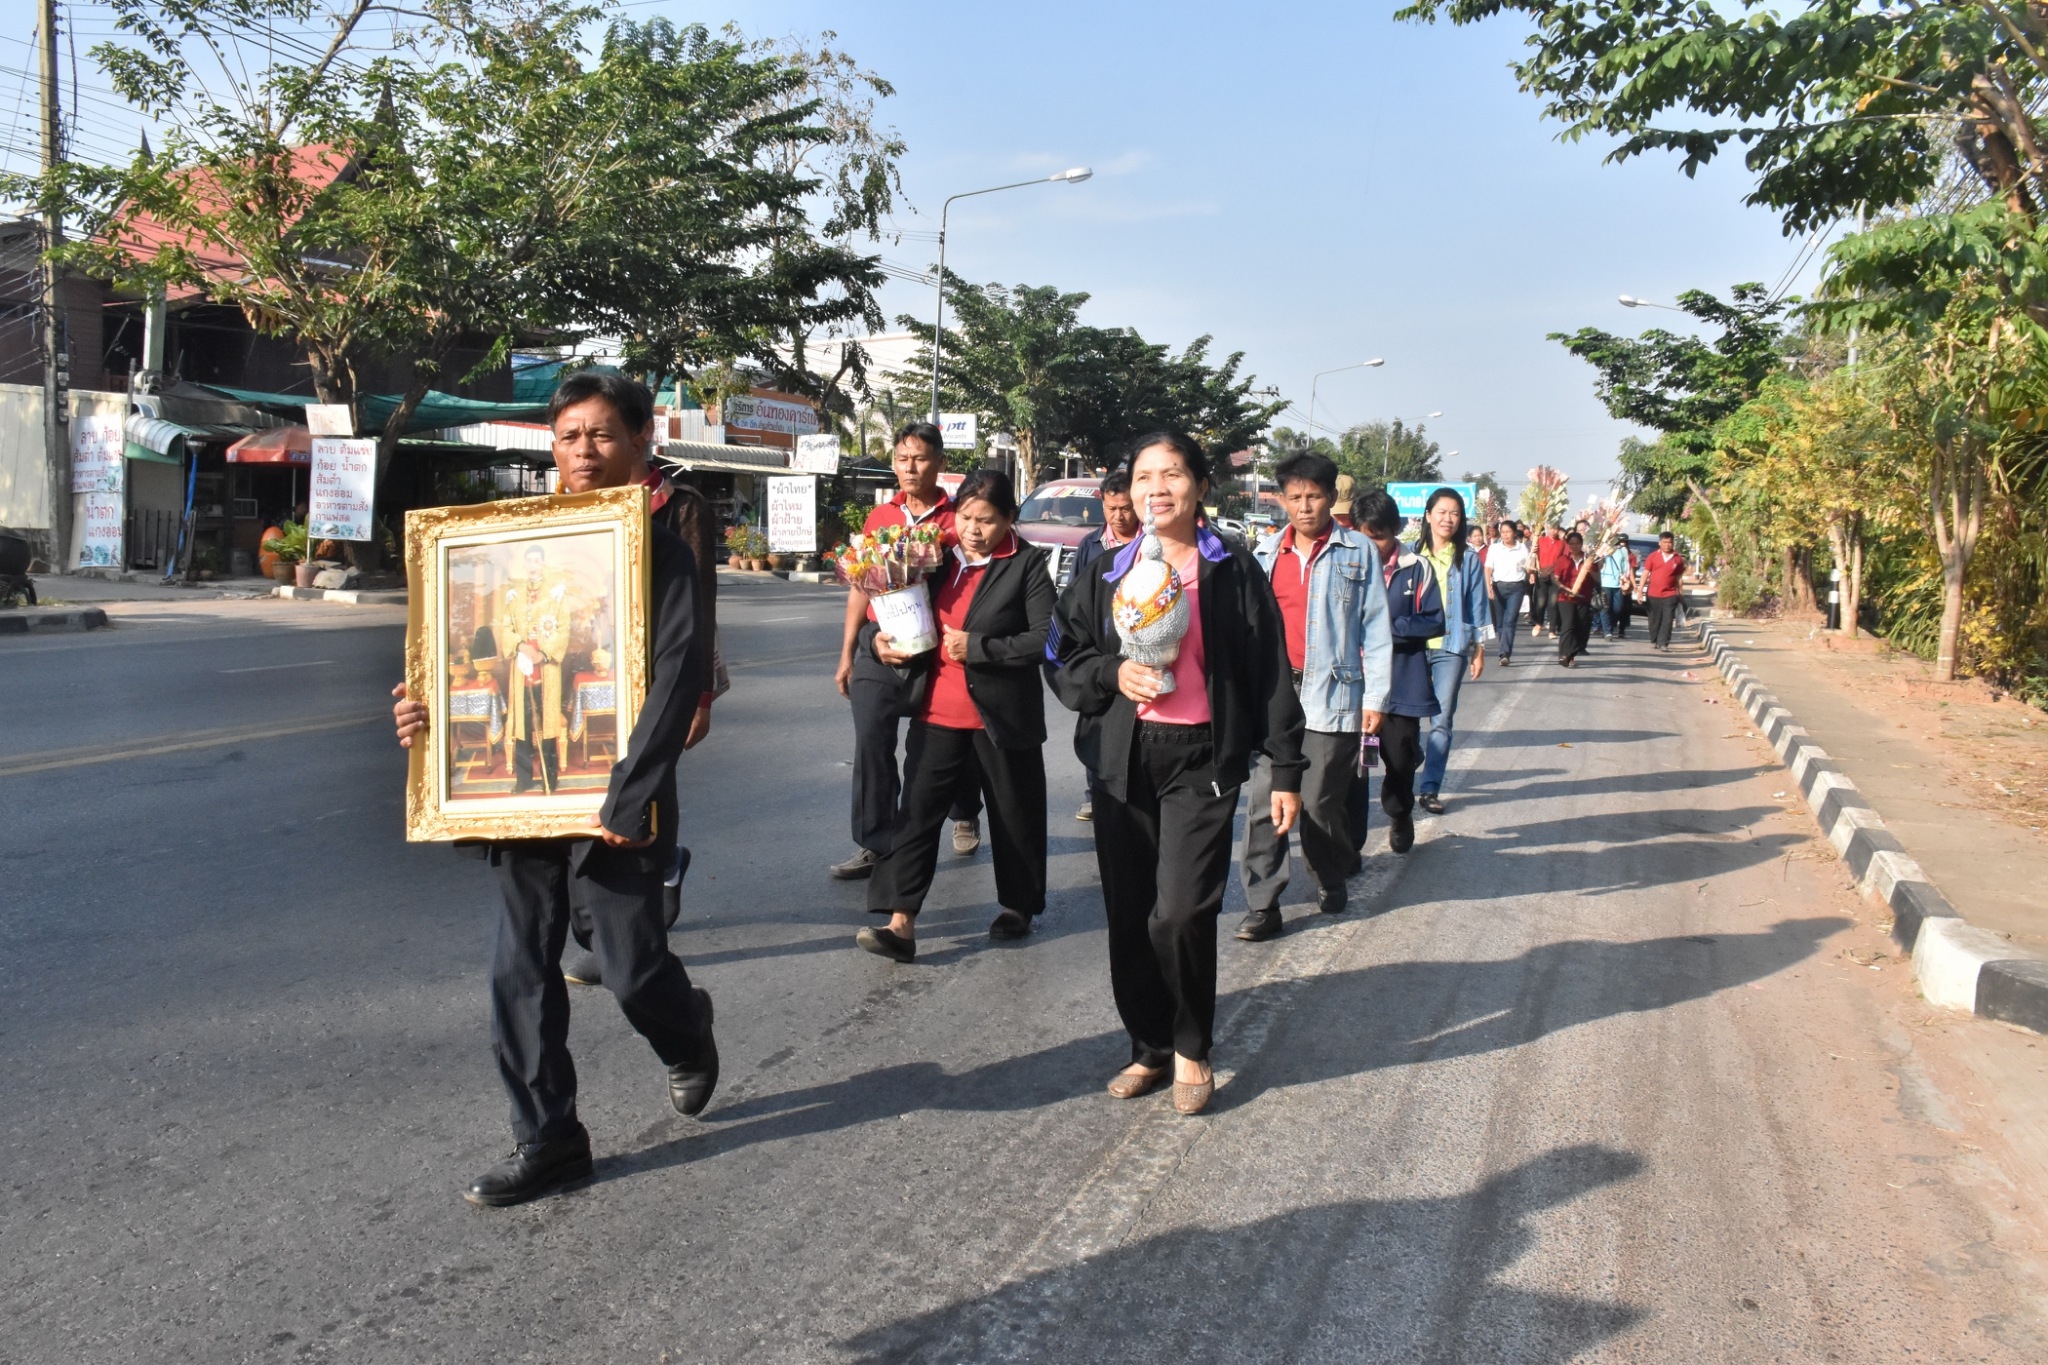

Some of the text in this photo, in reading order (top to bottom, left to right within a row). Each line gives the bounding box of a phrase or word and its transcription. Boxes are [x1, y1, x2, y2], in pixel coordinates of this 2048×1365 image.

[946, 421, 967, 432] ptt
[342, 456, 368, 473] น้ำตก
[316, 486, 353, 499] แกงอ่อม
[87, 494, 115, 520] น้ำตก
[316, 498, 369, 512] อาหารตามสั่ง
[771, 498, 803, 512] ผ้าไหม
[315, 513, 351, 523] กาแฟสด
[771, 513, 803, 526] ผ้าฝ้าย
